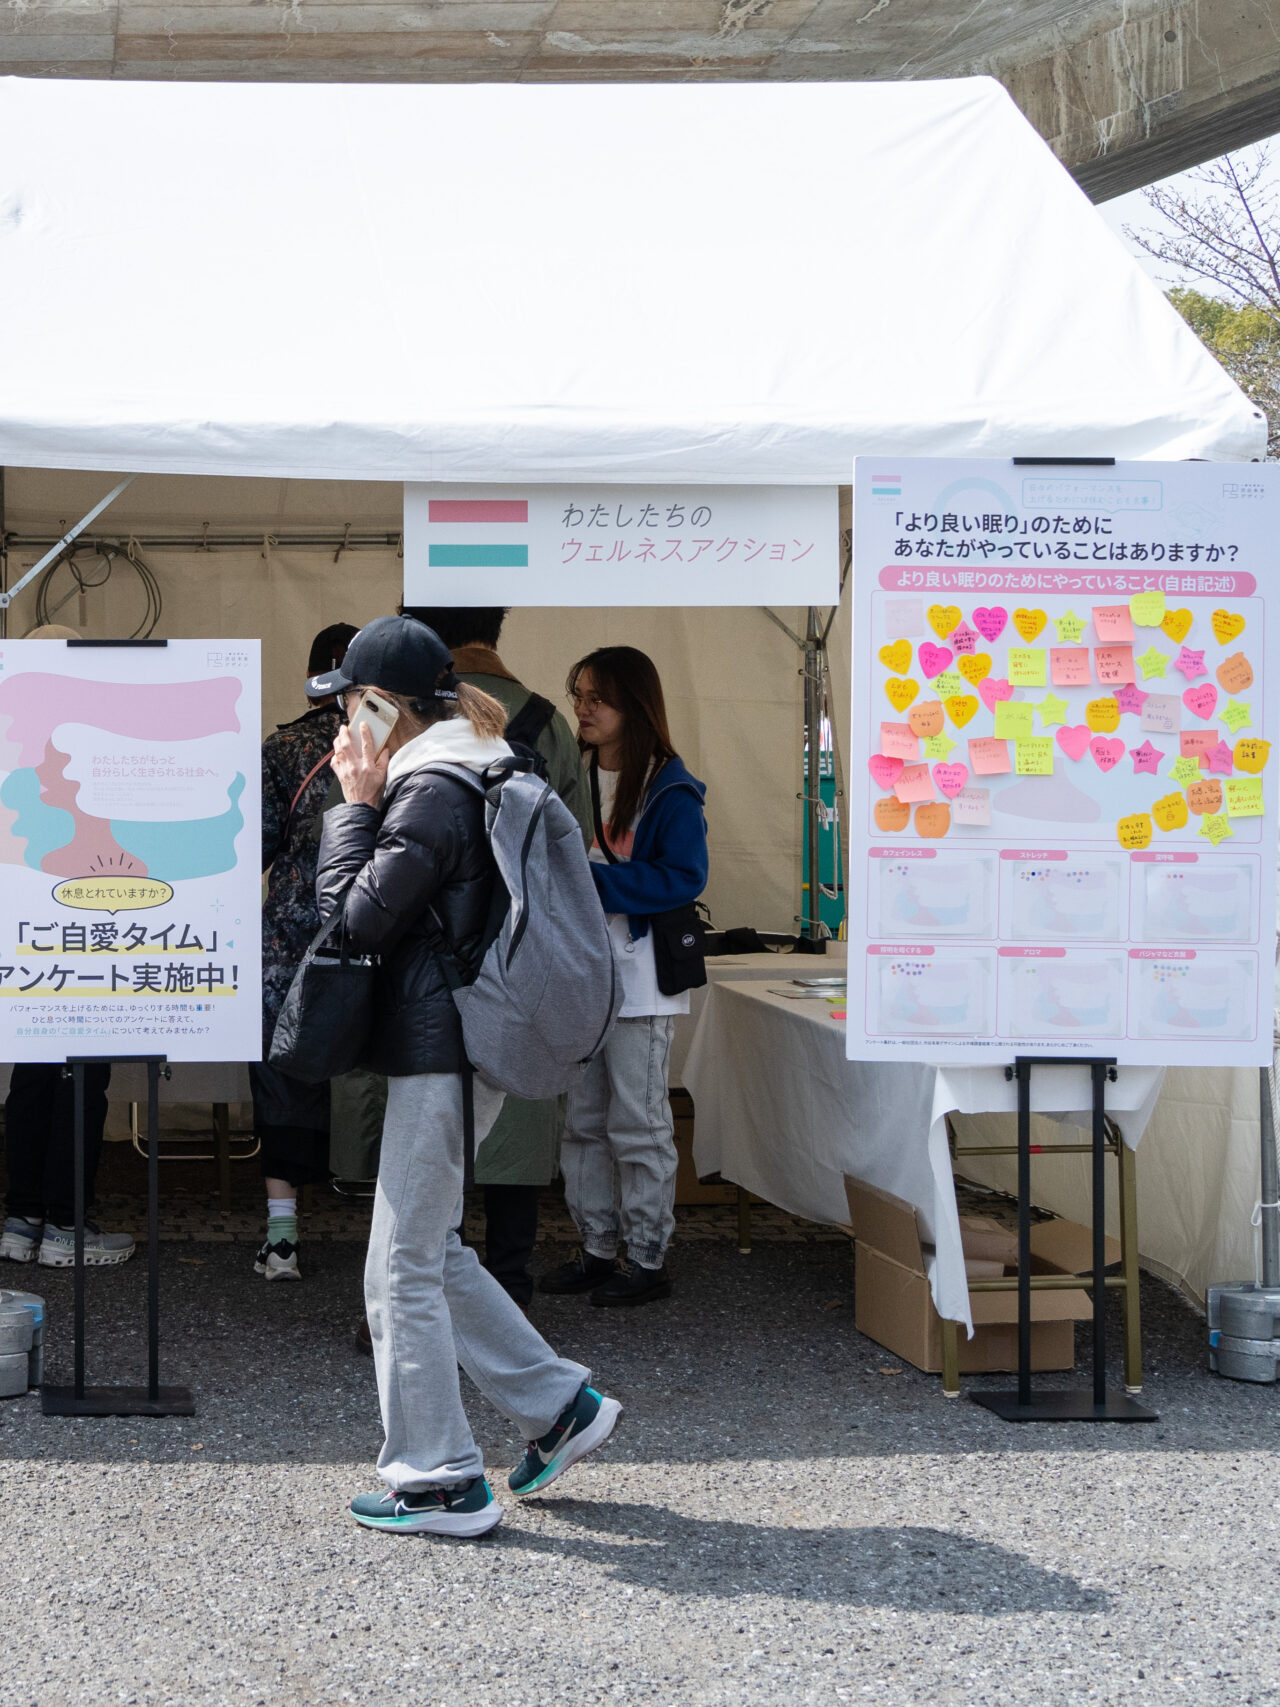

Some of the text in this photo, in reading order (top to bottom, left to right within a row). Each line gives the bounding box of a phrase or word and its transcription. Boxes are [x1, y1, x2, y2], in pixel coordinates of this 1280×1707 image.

[561, 502, 713, 529] わたしたちの
[895, 511, 1113, 535] 「より良い眠り」のために
[560, 537, 816, 564] ウェルネスアクション
[894, 538, 1240, 563] あなたがやっていることはありますか？
[896, 570, 1237, 593] より良い眠りのためにやっていること（自由記述）
[91, 754, 177, 766] わたしたちがもっと
[91, 766, 220, 778] 自分らしく生きられる社会へ。
[882, 849, 923, 857] カフェインレス
[1019, 851, 1049, 859] ストレッチ
[61, 885, 167, 900] 休息とれていますか？
[17, 921, 218, 953] 「ご自愛タイム」
[9, 1003, 216, 1013] パフォーマンスを上げるためには、ゆっくりする時間も重要！
[31, 1015, 195, 1024] ひと息つく時間についてのアンケートに答えて、
[16, 1026, 211, 1035] 自分自身の「ご自愛タイム」について考えてみませんか？
